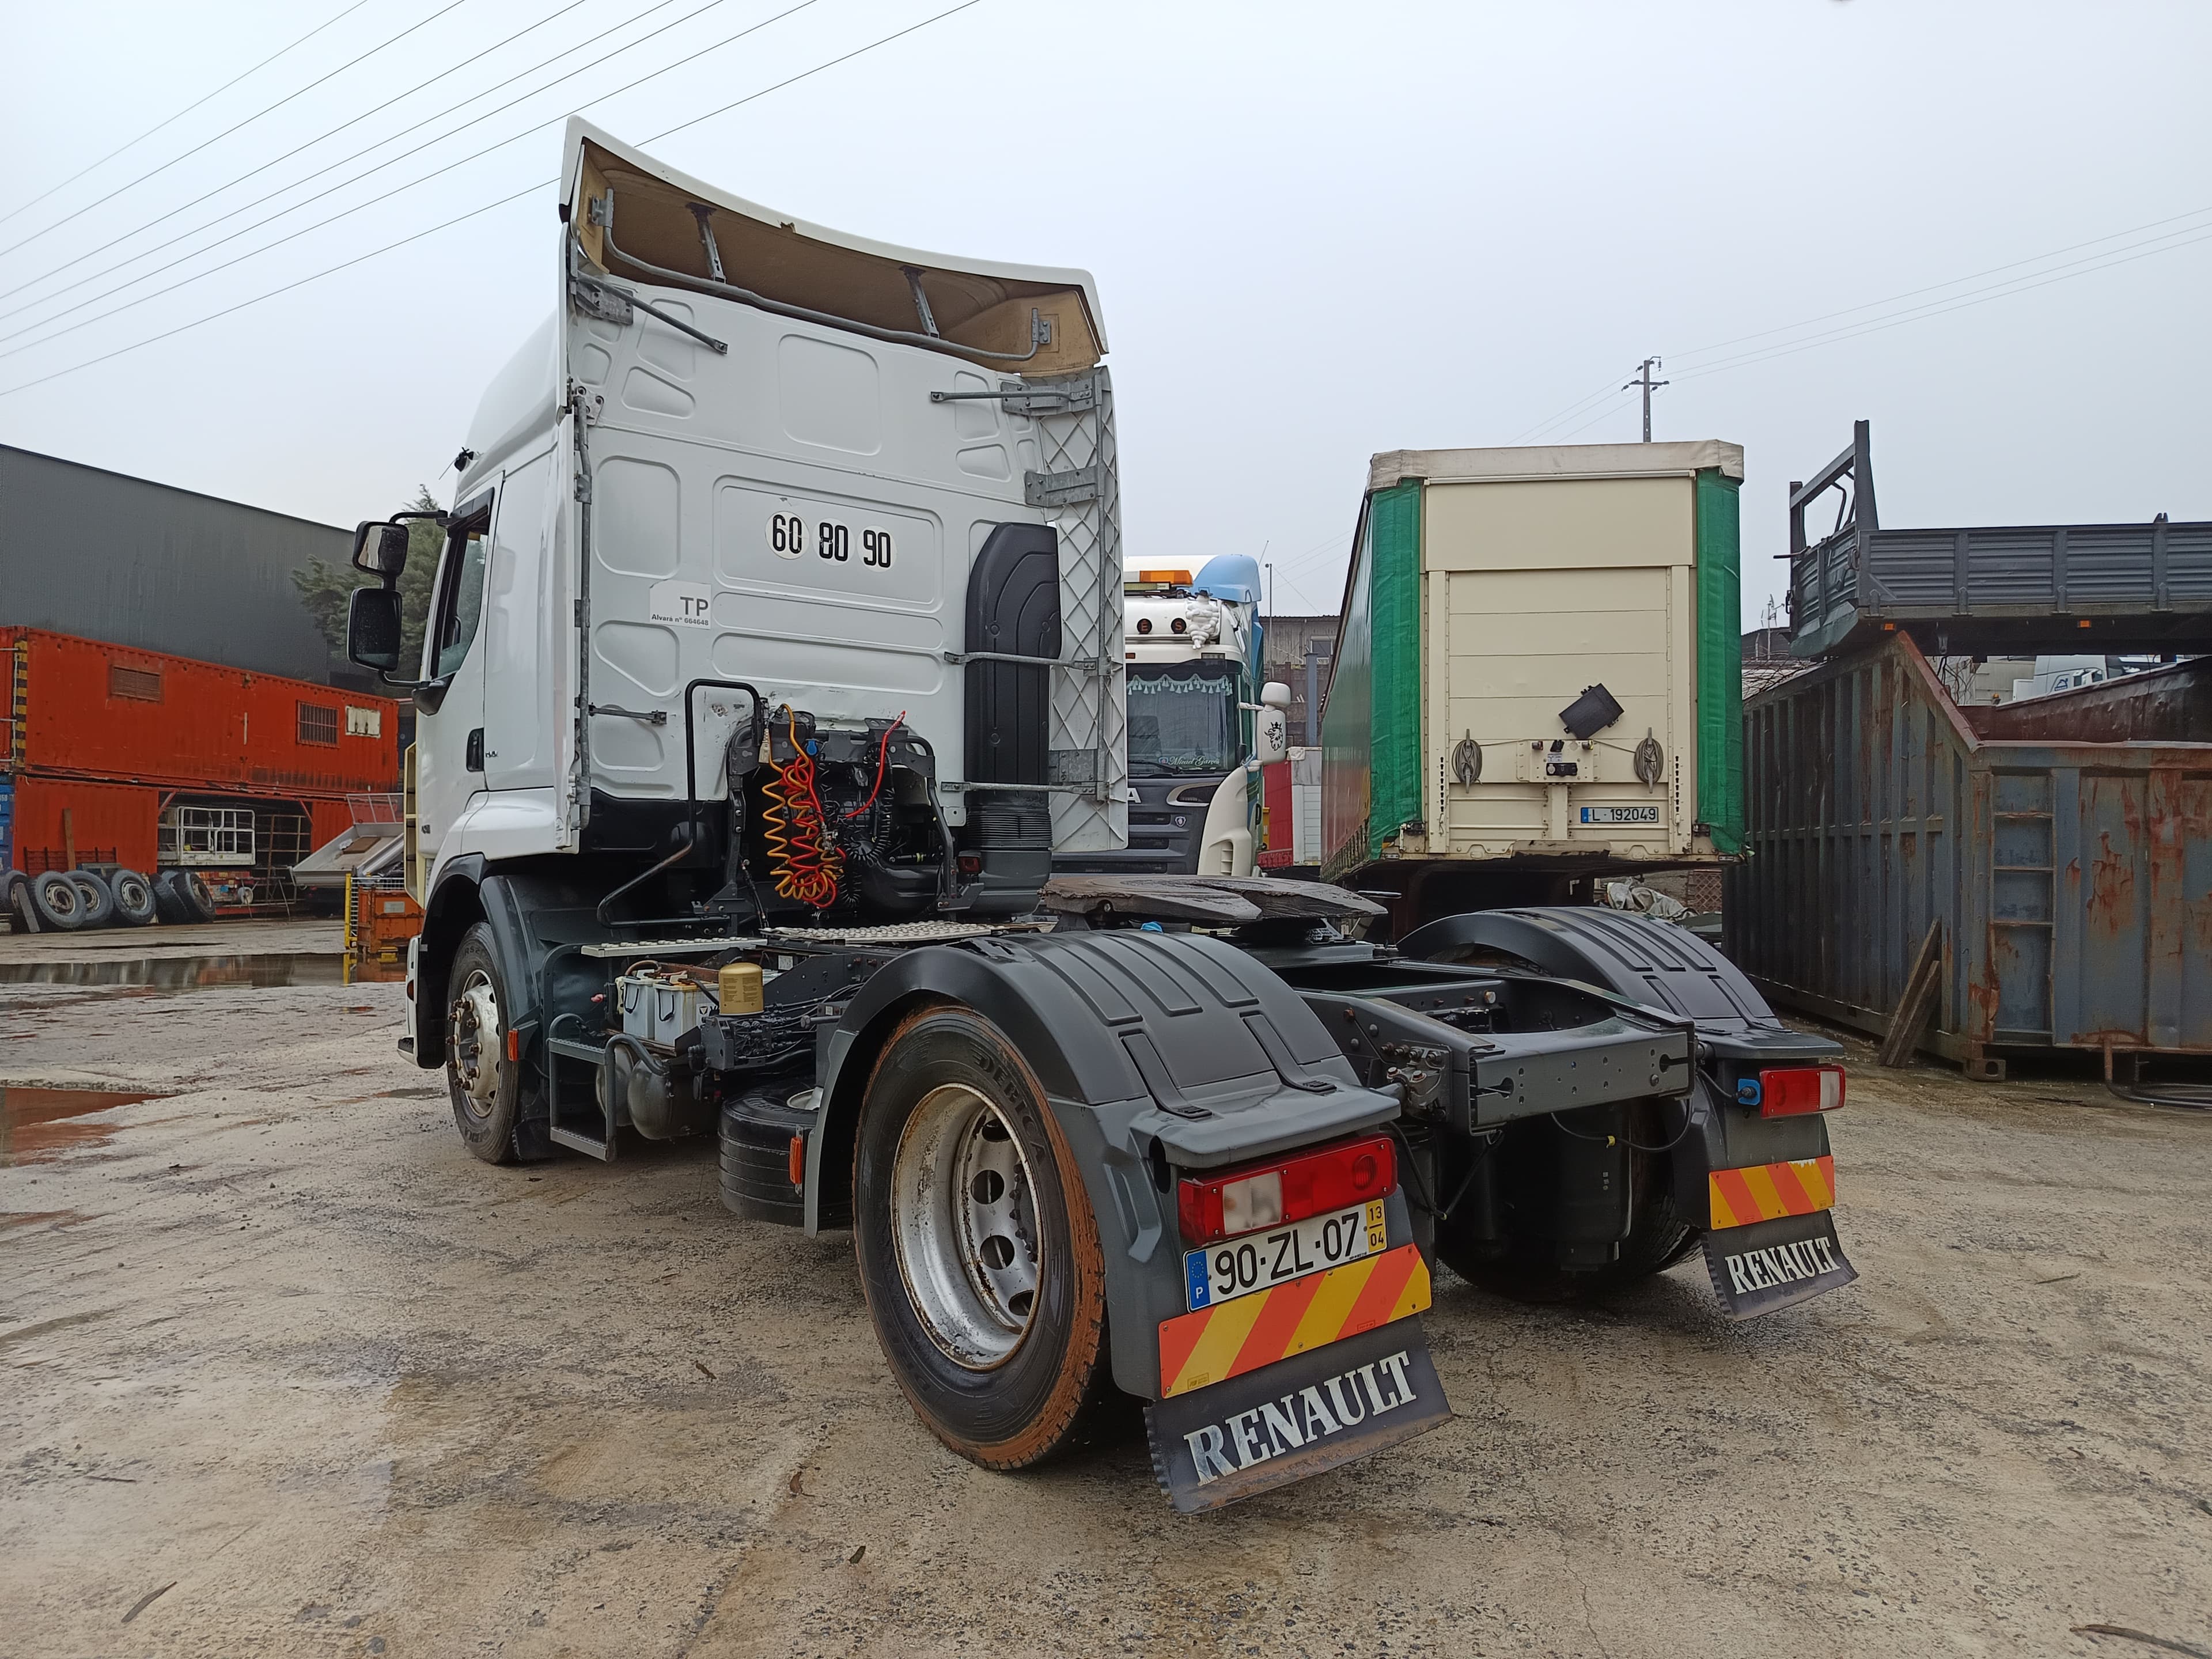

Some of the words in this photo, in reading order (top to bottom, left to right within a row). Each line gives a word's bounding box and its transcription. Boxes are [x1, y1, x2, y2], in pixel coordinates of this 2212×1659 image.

[772, 514, 802, 554] 60
[819, 522, 849, 562] 80
[863, 530, 891, 567] 90
[680, 596, 709, 616] TP
[652, 614, 673, 622] Alvará
[1369, 1206, 1382, 1221] 13
[1370, 1232, 1384, 1247] 04
[1724, 1236, 1842, 1295] RENAULT
[1195, 1286, 1203, 1300] P
[1183, 1350, 1417, 1487] RENAULT
